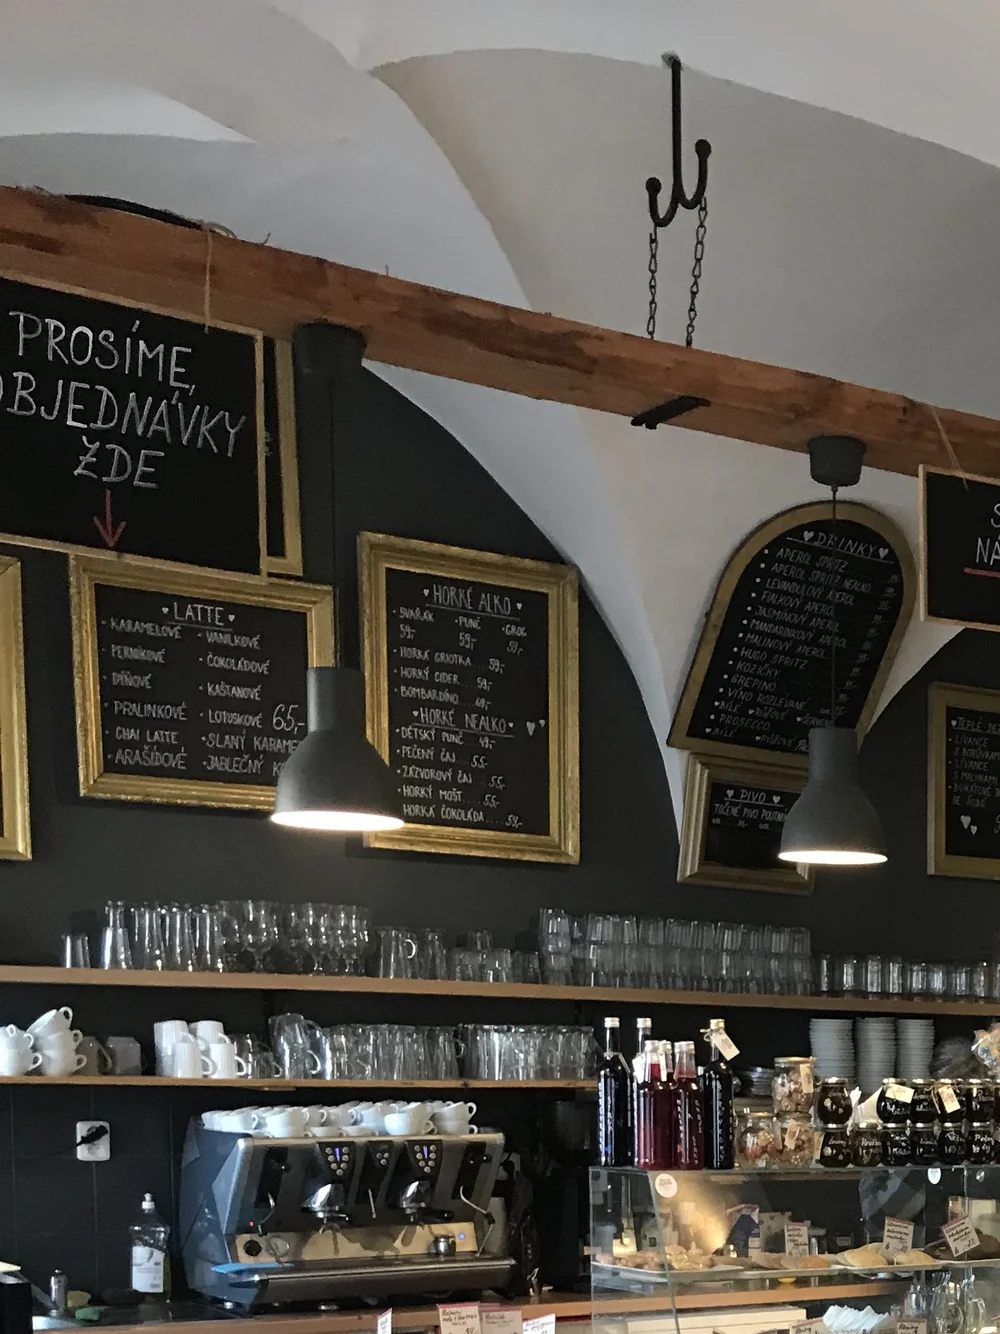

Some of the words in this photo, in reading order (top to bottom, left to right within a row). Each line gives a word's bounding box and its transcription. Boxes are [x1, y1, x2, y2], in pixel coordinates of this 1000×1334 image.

[776, 547, 812, 565] APEROL
[771, 563, 806, 580] APEROL
[433, 584, 474, 609] HORKÉ
[479, 593, 511, 615] ALKO
[173, 601, 224, 626] LATTE
[459, 616, 481, 630] PUNČ
[110, 616, 183, 639] KARAMELOVÉ
[205, 631, 261, 650] VANILKOVÉ
[111, 644, 166, 663] PERNÍKOVÉ
[400, 646, 430, 661] HORKÁ
[741, 647, 767, 661] HUGO
[771, 654, 808, 670] SPRITZ
[795, 645, 826, 659] APEROL
[206, 651, 270, 675] ČOKOLÁDOVÉ
[400, 666, 430, 681] HORKÝ
[434, 671, 460, 685] CIDER
[731, 673, 777, 692] GREPINO
[207, 681, 262, 701] KAŠTANOVÉ
[400, 685, 459, 705] BOMBARDÍNO
[727, 687, 753, 702] VÍNO
[114, 700, 188, 721] PRALINKOVÉ
[208, 709, 263, 729] LOTUSKOVÉ
[420, 707, 456, 727] HORKÉ
[465, 713, 506, 733] NEALKO
[719, 713, 771, 731] PROSECCO
[958, 716, 982, 729] TEPLÉ
[115, 726, 140, 741] CHAI
[146, 730, 179, 744] LATTE
[206, 729, 247, 750] SLANÝ
[254, 736, 301, 754] KARAME
[115, 745, 188, 770] ARAŠÍDOVÉ
[402, 744, 435, 760] PEČENÝ
[440, 748, 456, 763] ČAJ
[206, 753, 264, 774] JABLEČNÝ
[458, 770, 472, 784] ČAJ
[403, 784, 433, 799] HORKÝ
[439, 788, 463, 802] MOŠT
[740, 789, 767, 803] PIVO
[403, 804, 436, 818] HORKÁ
[441, 804, 484, 822] ČOKOLÁDA
[743, 807, 759, 819] PIVO
